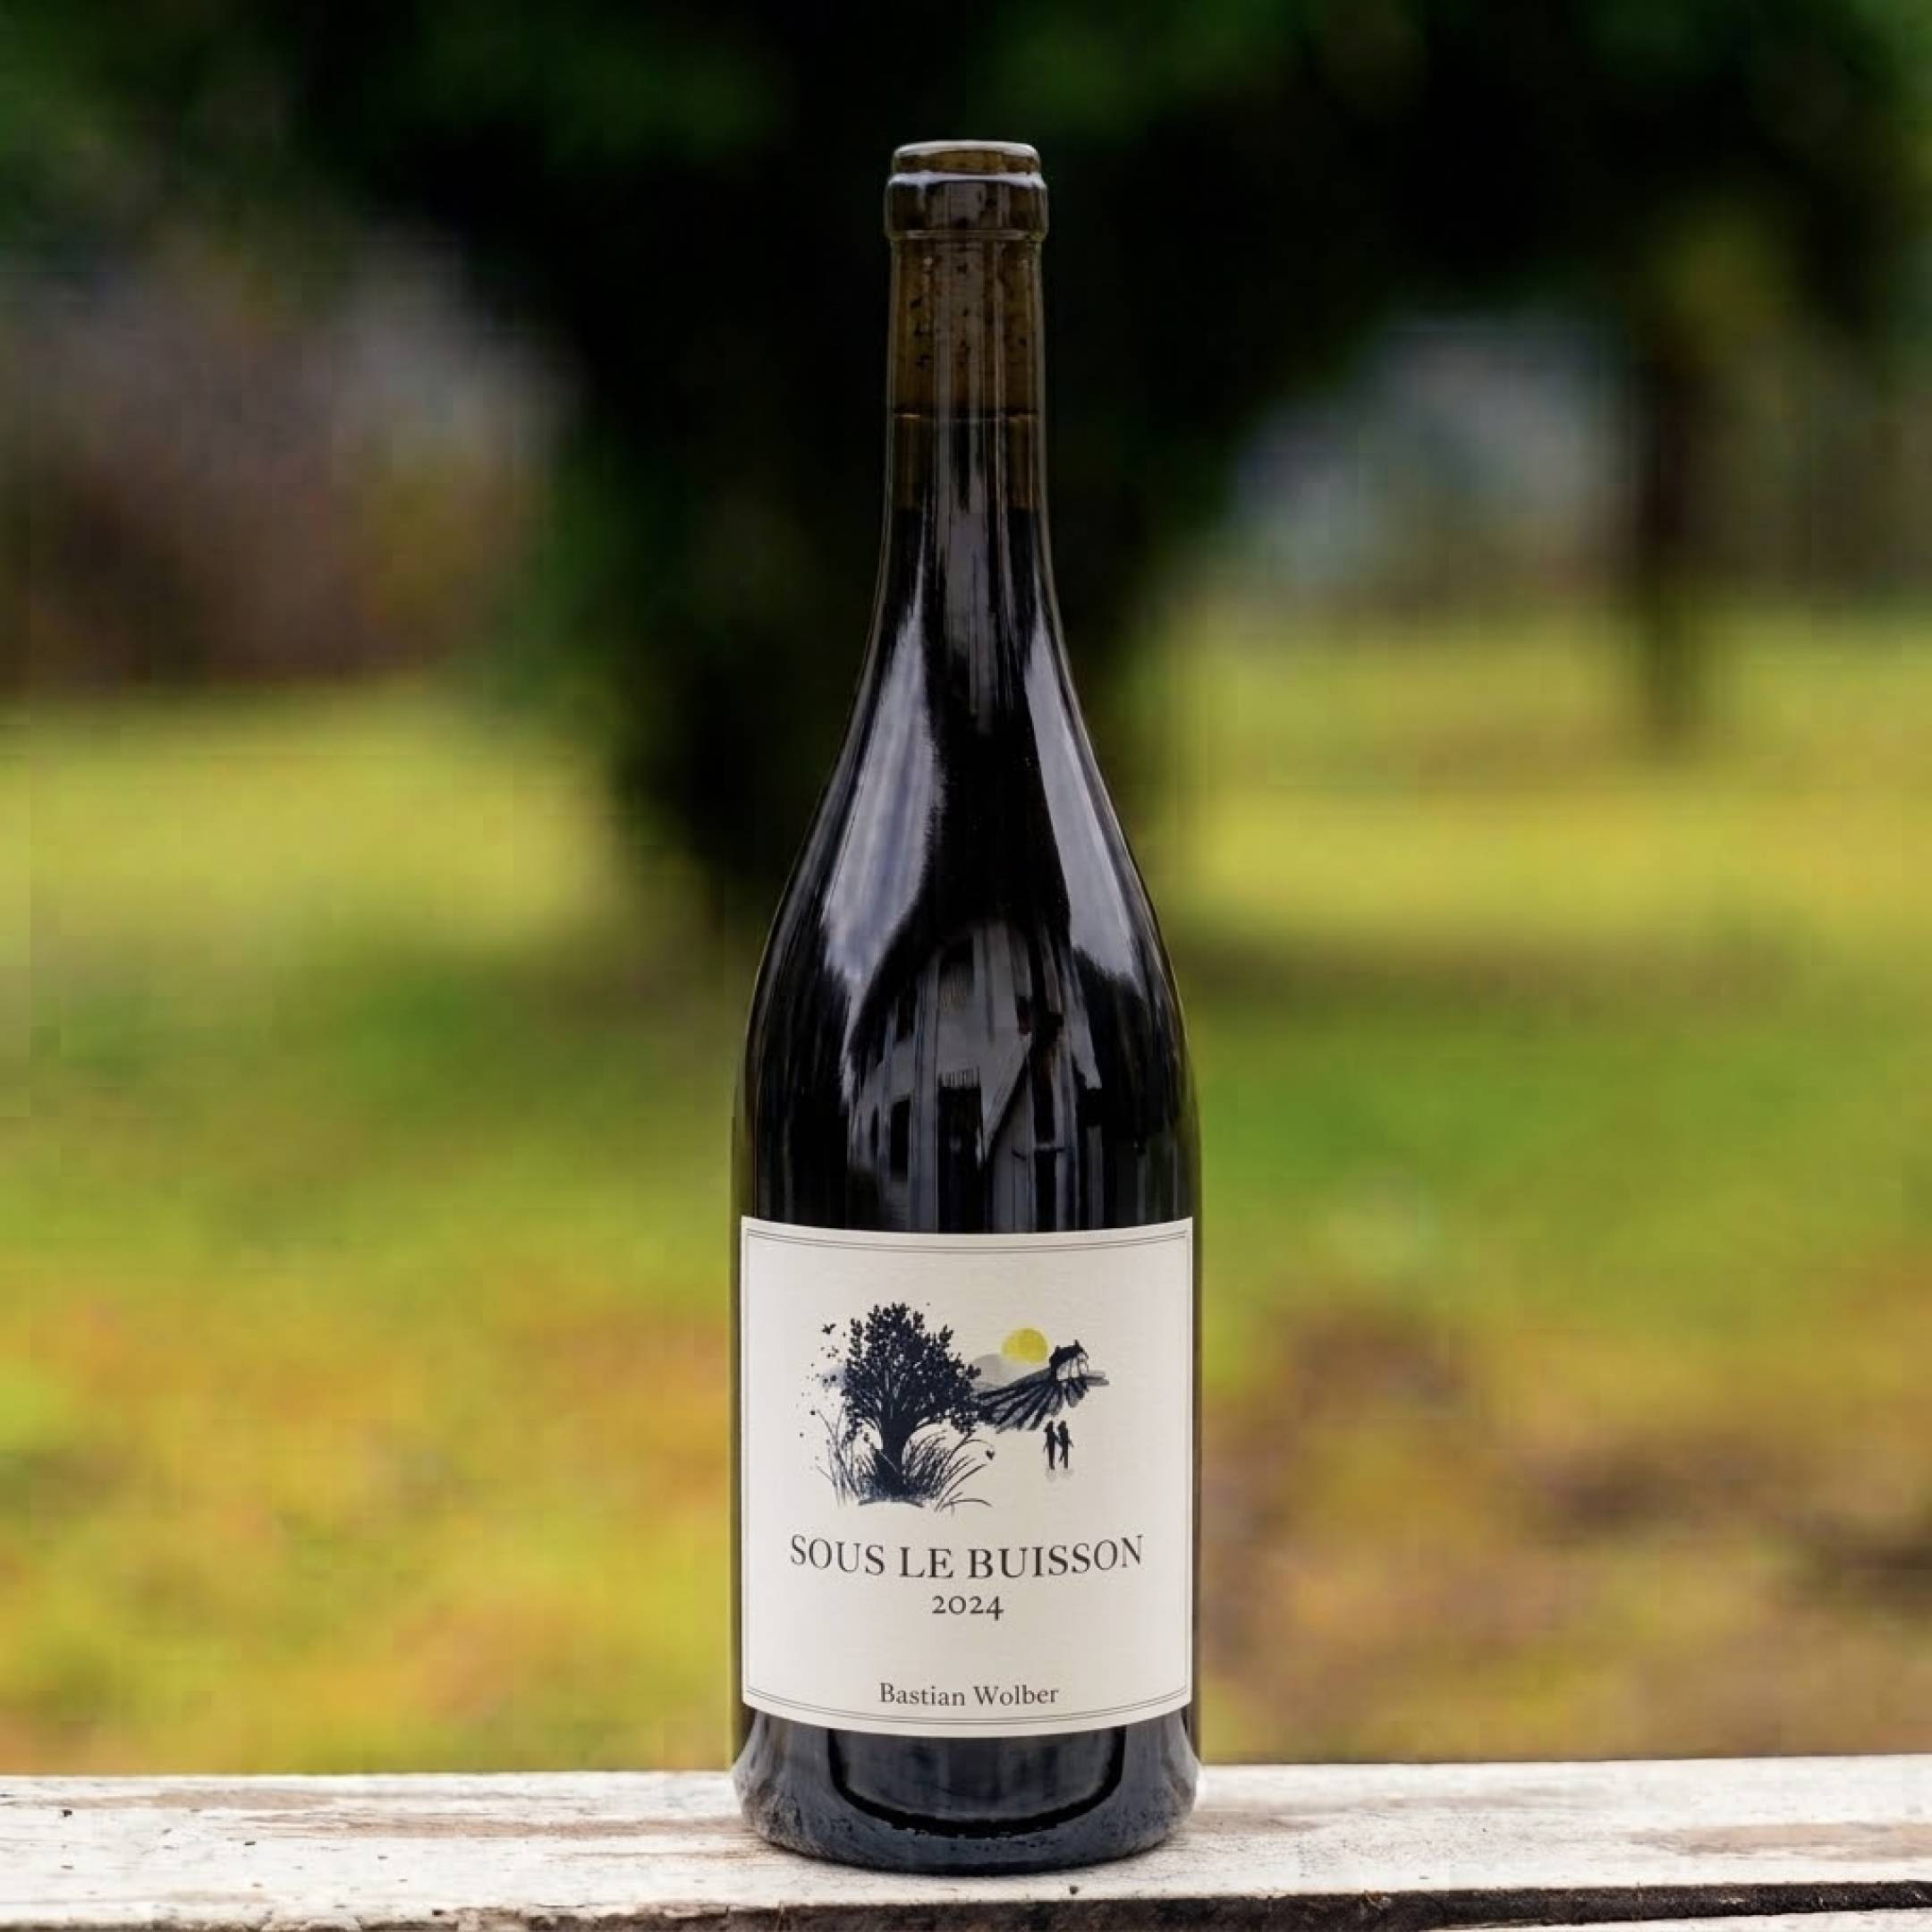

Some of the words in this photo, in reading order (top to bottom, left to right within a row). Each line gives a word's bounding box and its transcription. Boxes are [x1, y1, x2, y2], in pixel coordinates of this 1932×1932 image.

[791, 1534, 886, 1576] SOUS
[899, 1547, 954, 1579] LE
[967, 1534, 1144, 1580] BUISSON
[931, 1595, 1004, 1622] 2024
[879, 1682, 966, 1707] Bastian
[972, 1684, 1059, 1707] Wolber
